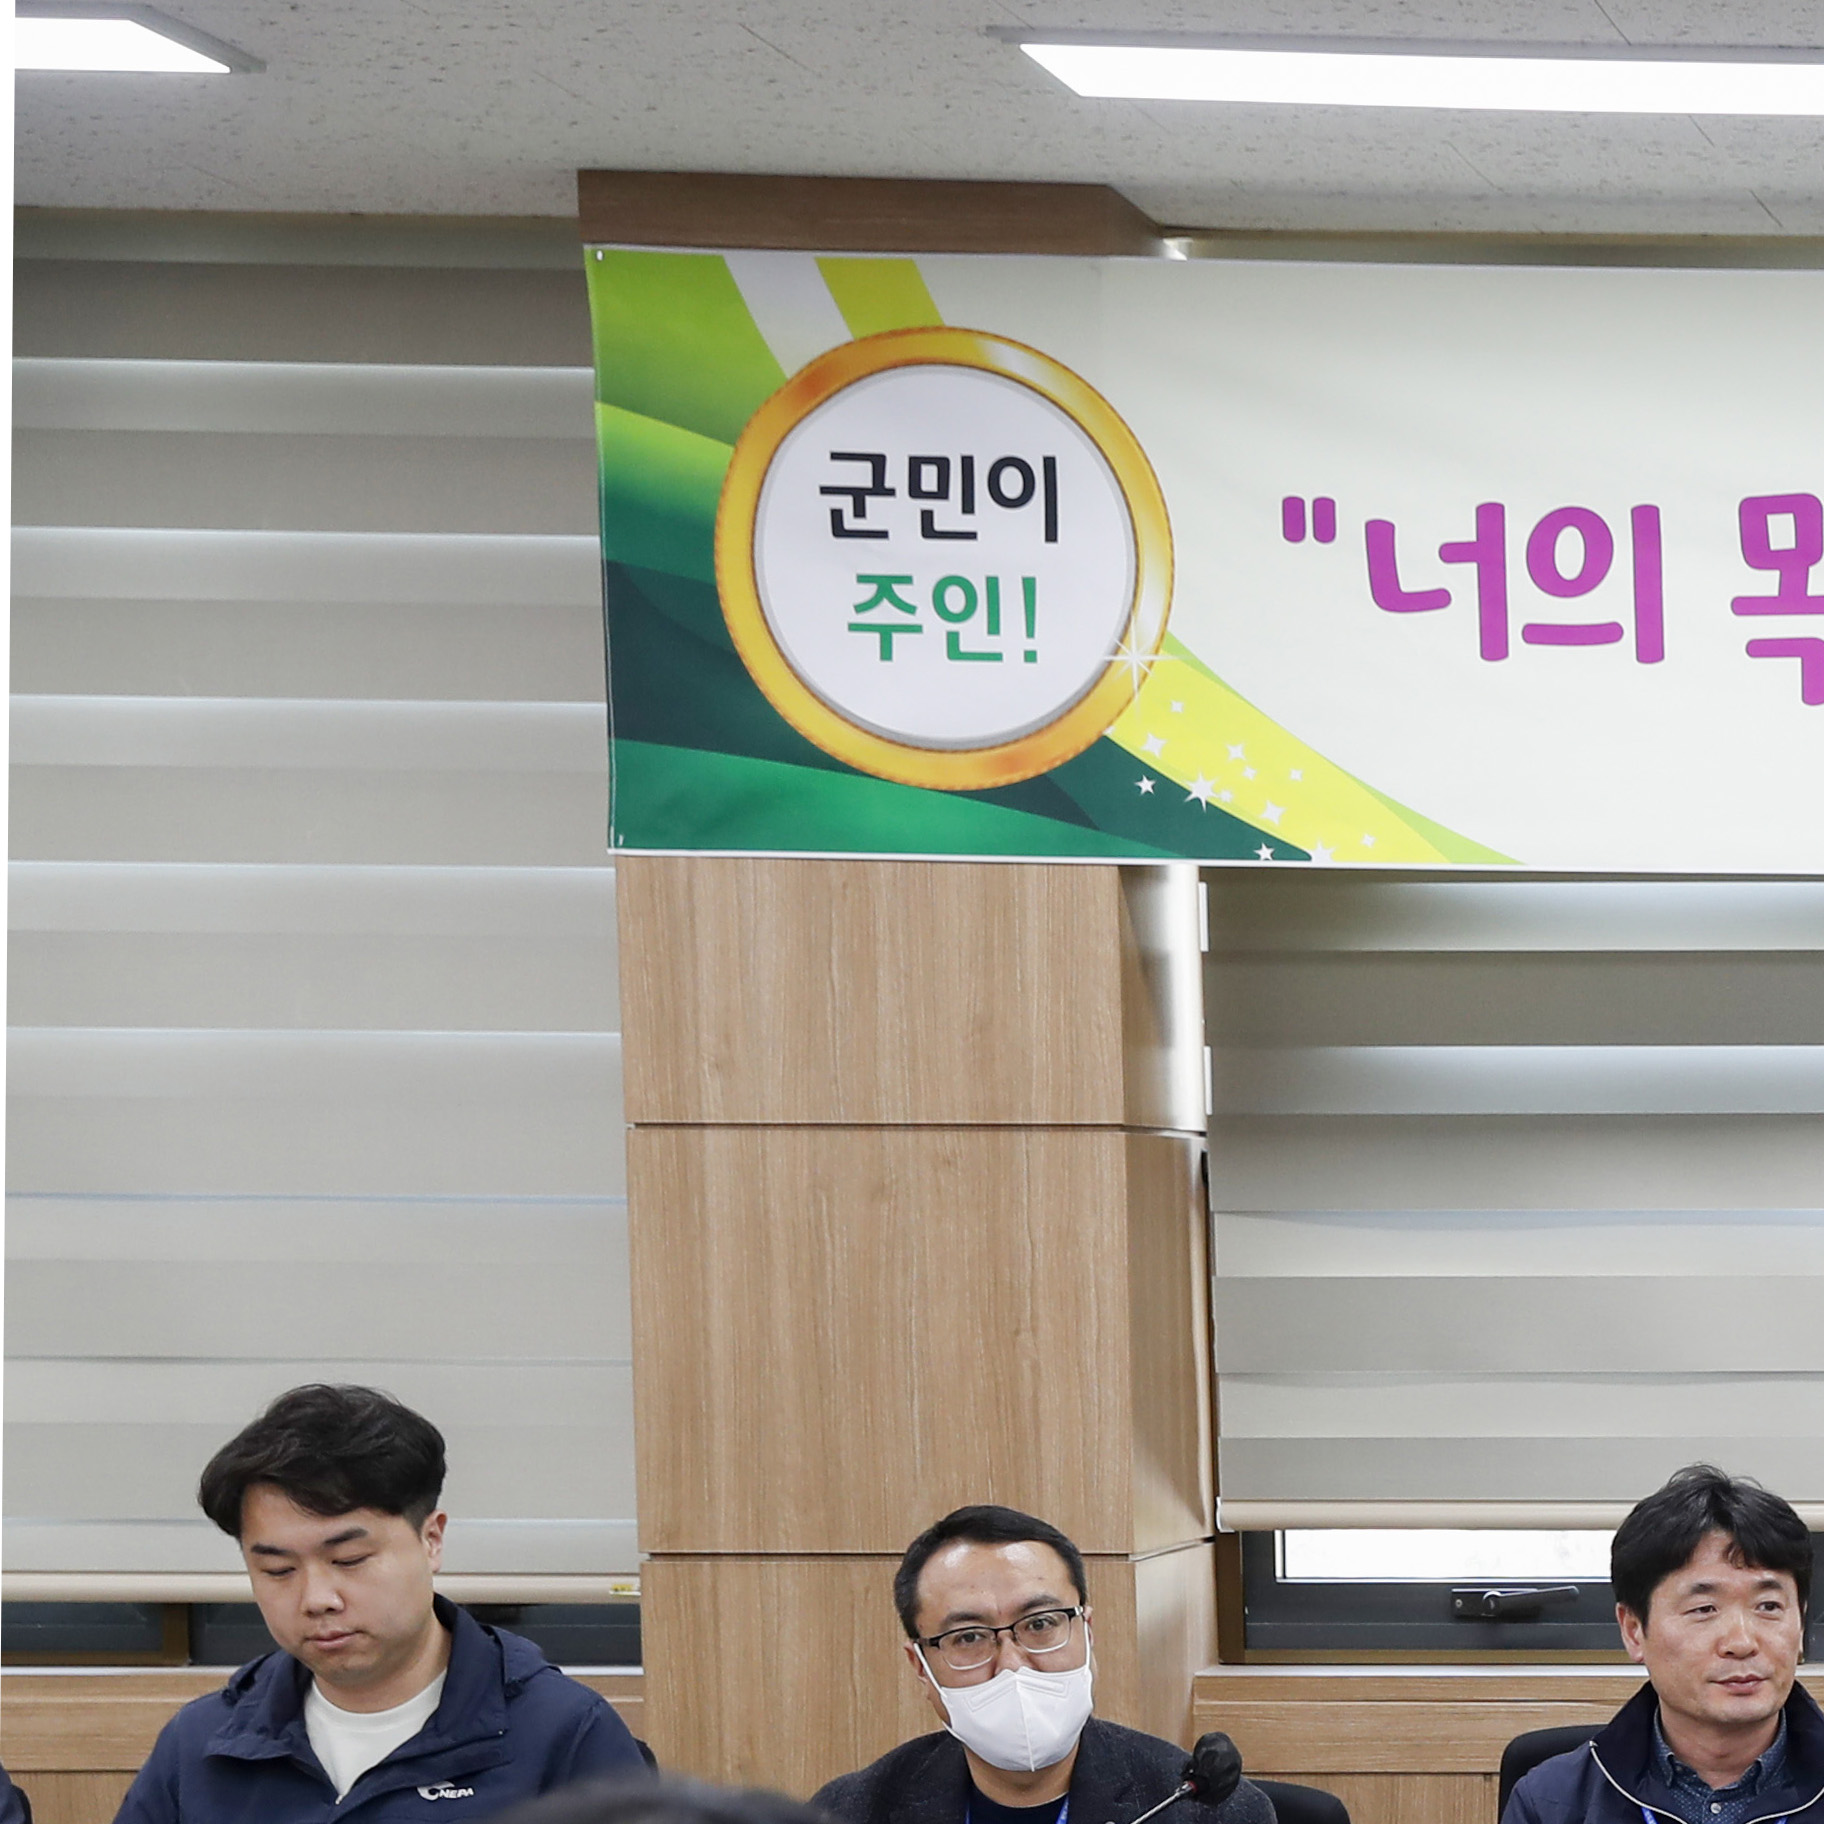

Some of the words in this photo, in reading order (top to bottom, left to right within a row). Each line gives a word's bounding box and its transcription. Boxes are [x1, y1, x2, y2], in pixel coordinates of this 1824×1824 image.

[818, 450, 1060, 544] 군민이
[846, 573, 1039, 665] 주인!
[1282, 495, 1665, 665] "너의
[438, 1787, 475, 1799] NEPA
